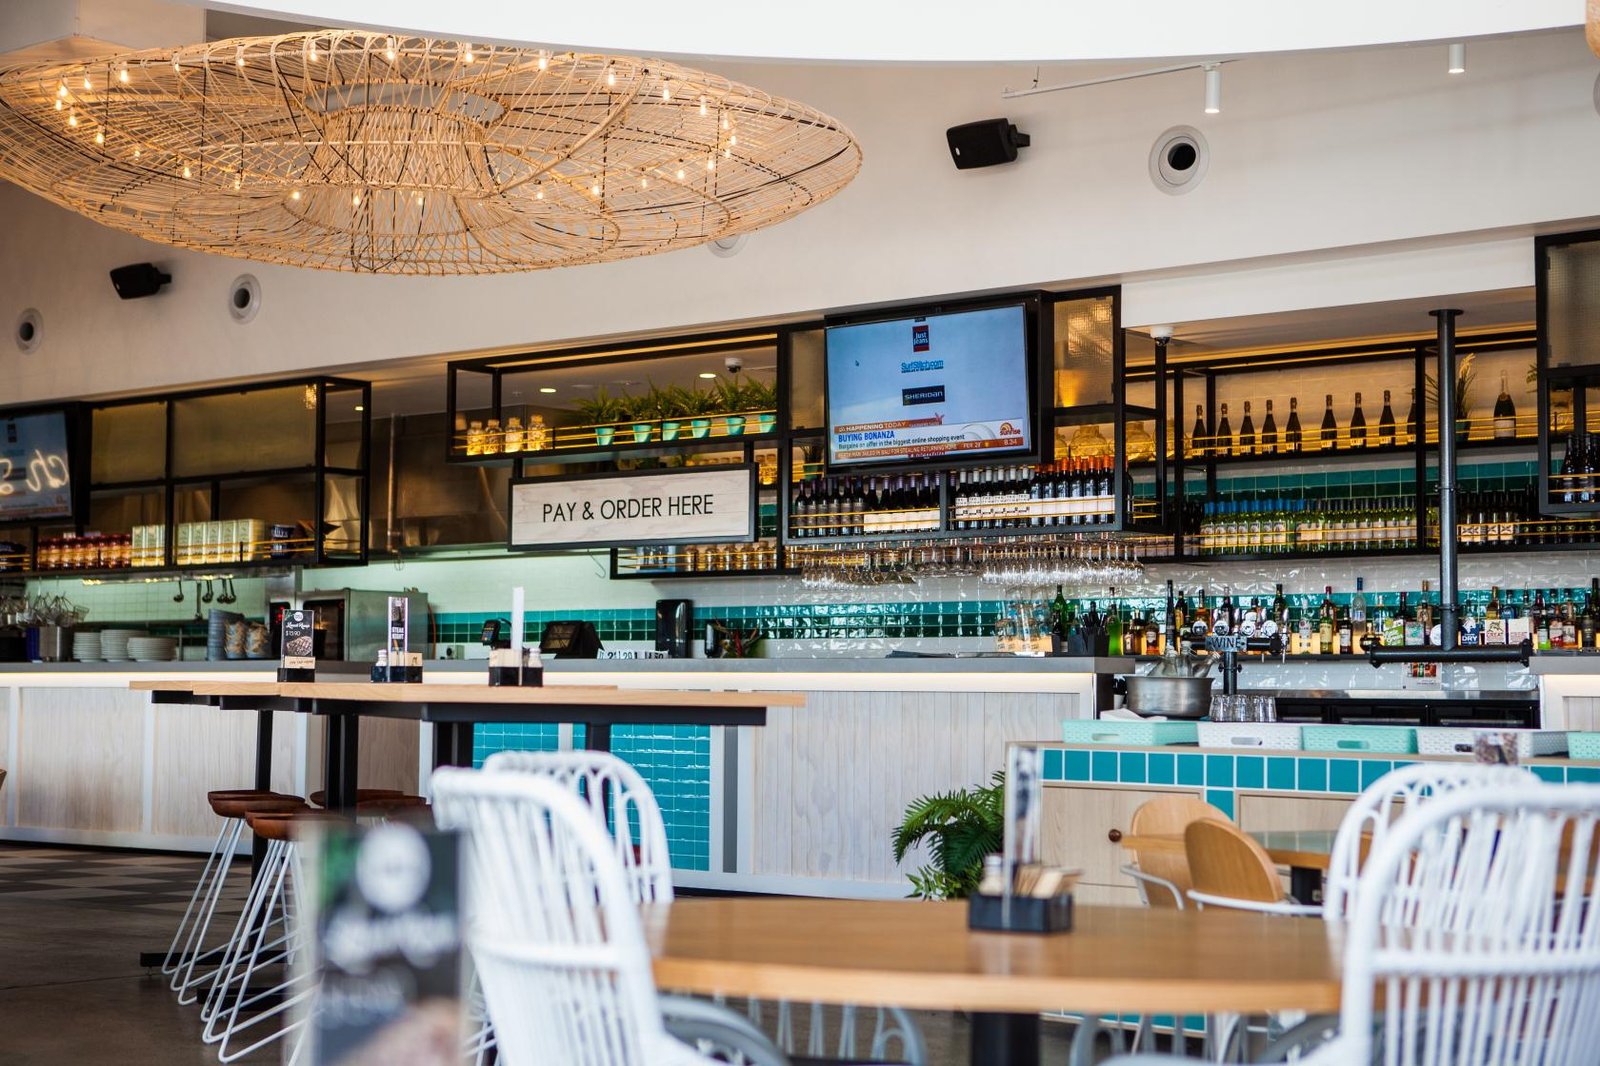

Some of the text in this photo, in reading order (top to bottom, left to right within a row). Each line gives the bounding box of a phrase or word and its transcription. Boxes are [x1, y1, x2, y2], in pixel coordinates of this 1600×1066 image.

[846, 423, 884, 432] HAPPENING
[884, 421, 906, 430] TODAY
[838, 431, 895, 443] BUYING BONANZA
[893, 438, 911, 447] biggest
[927, 434, 950, 443] shopping
[543, 494, 714, 523] PAY & ORDER HERE
[1211, 636, 1241, 648] WINE
